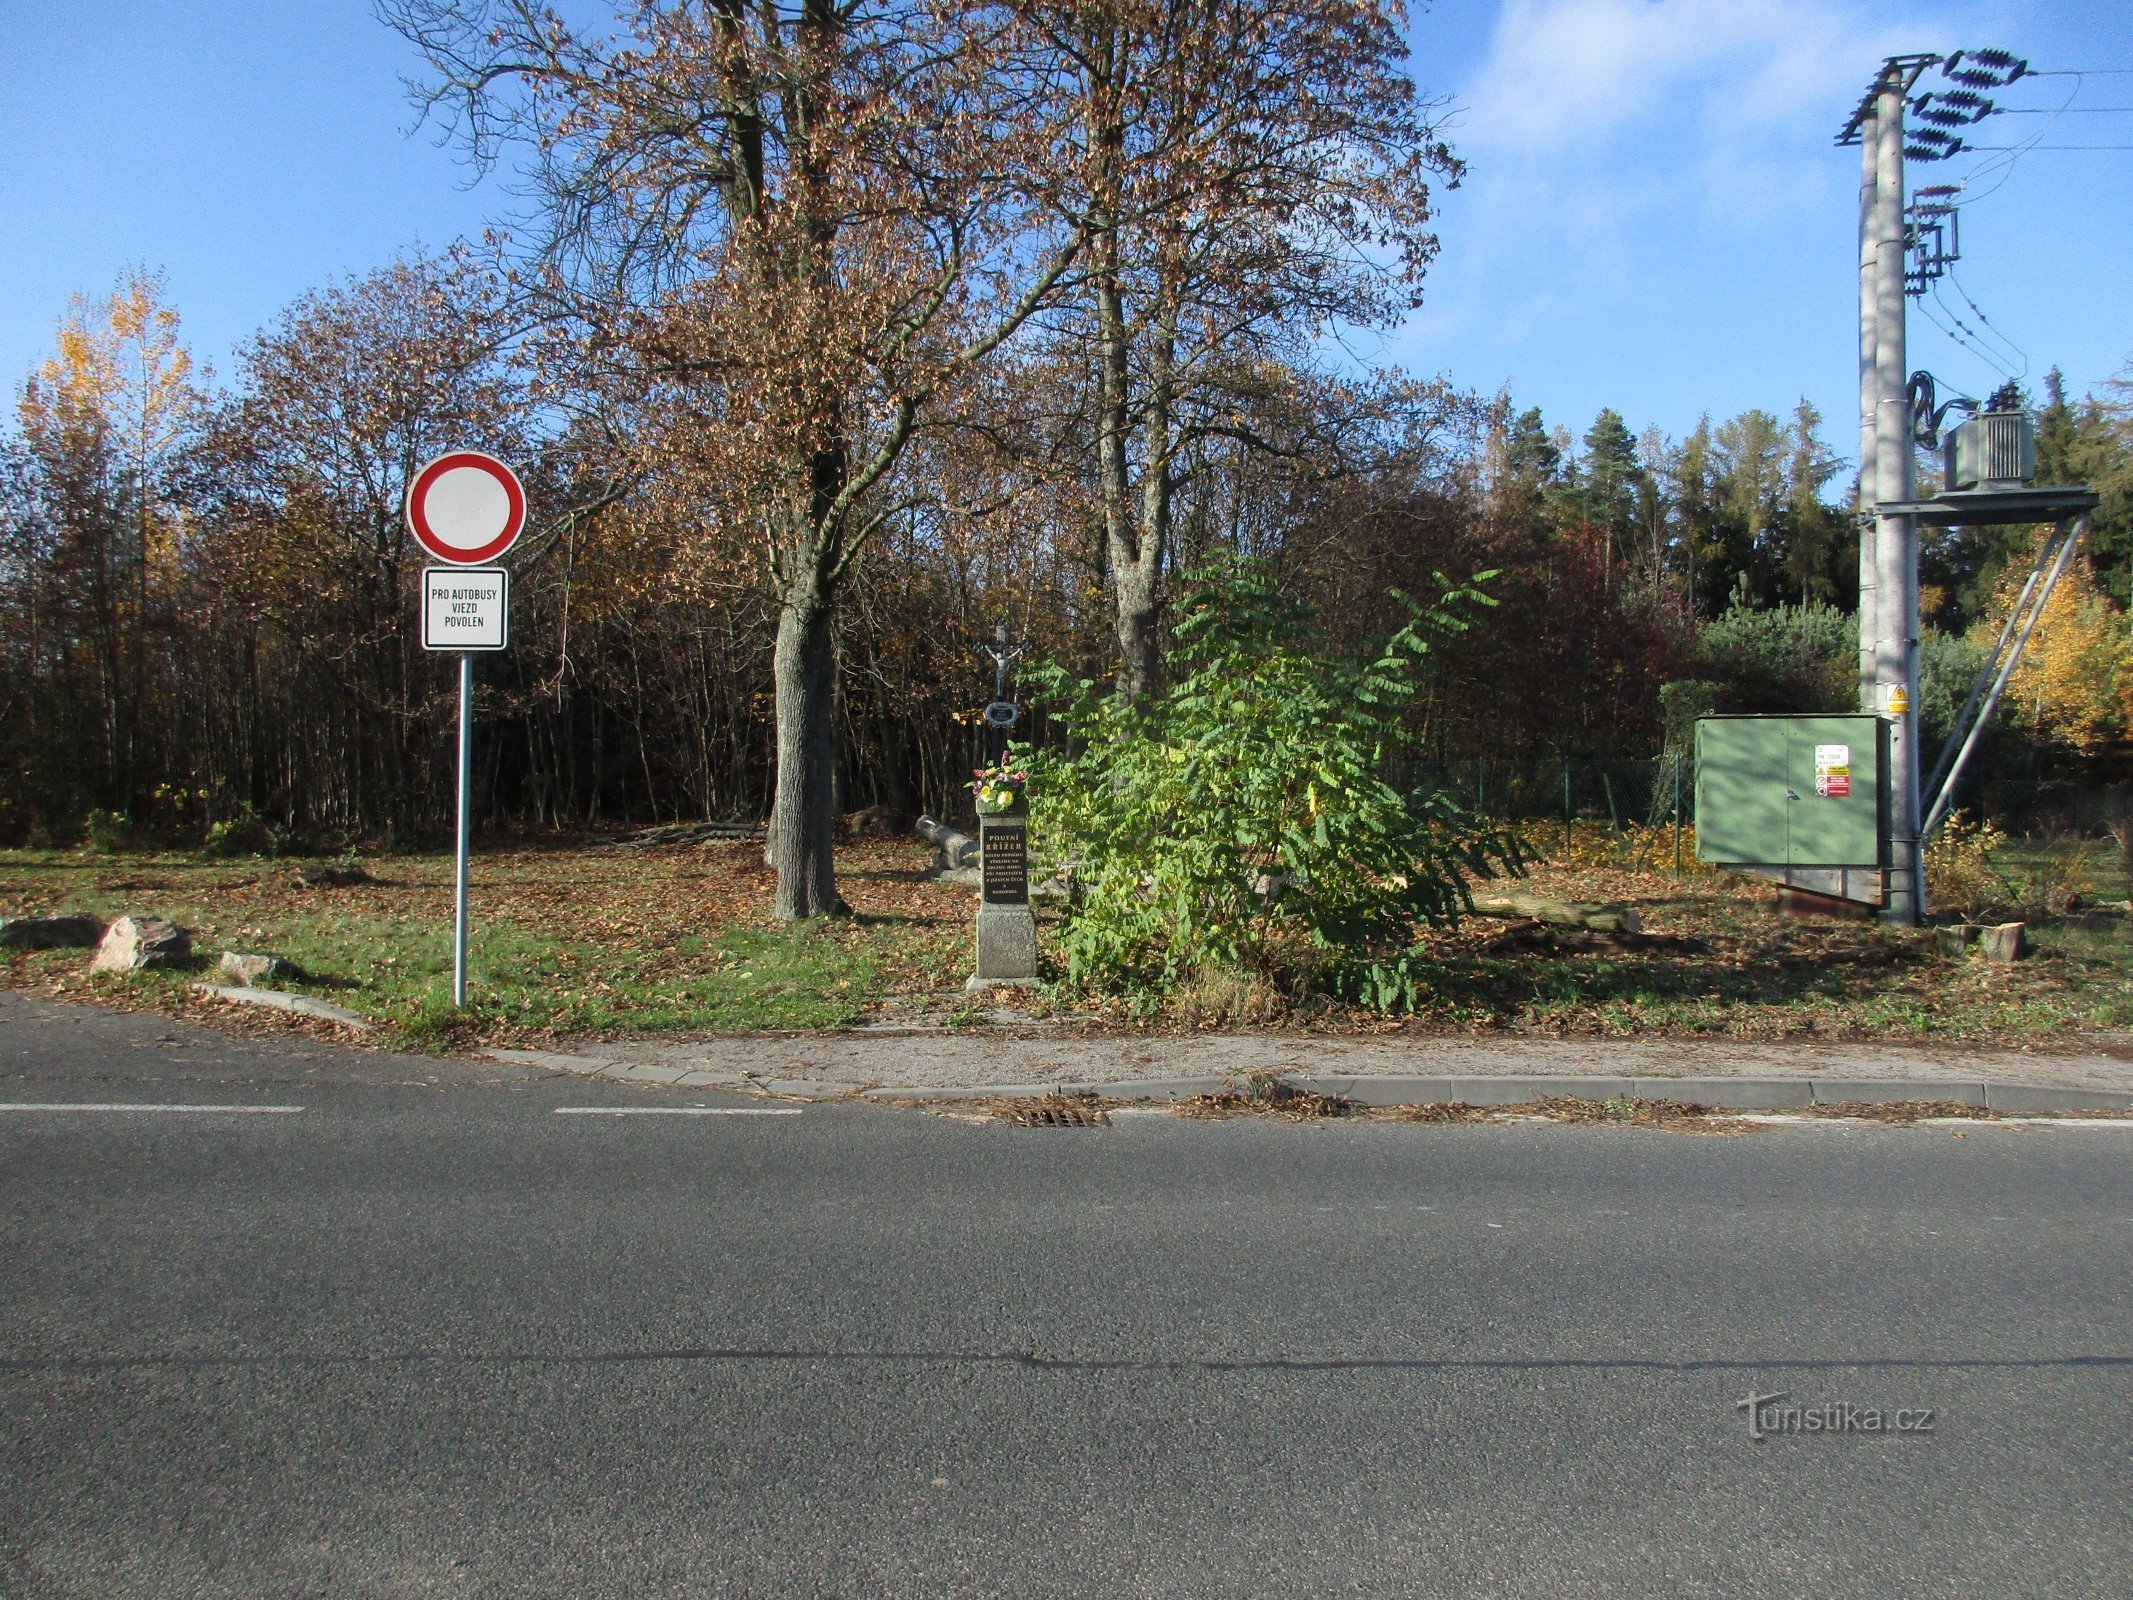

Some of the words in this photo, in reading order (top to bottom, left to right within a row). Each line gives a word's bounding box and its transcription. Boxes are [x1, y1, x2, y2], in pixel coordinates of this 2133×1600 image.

[432, 589, 449, 600] PRO
[452, 589, 497, 600] AUTOBUSY
[452, 603, 478, 614] VJEZD
[445, 617, 484, 627] POVOLEN
[986, 841, 1022, 850] KŘÍŽEK
